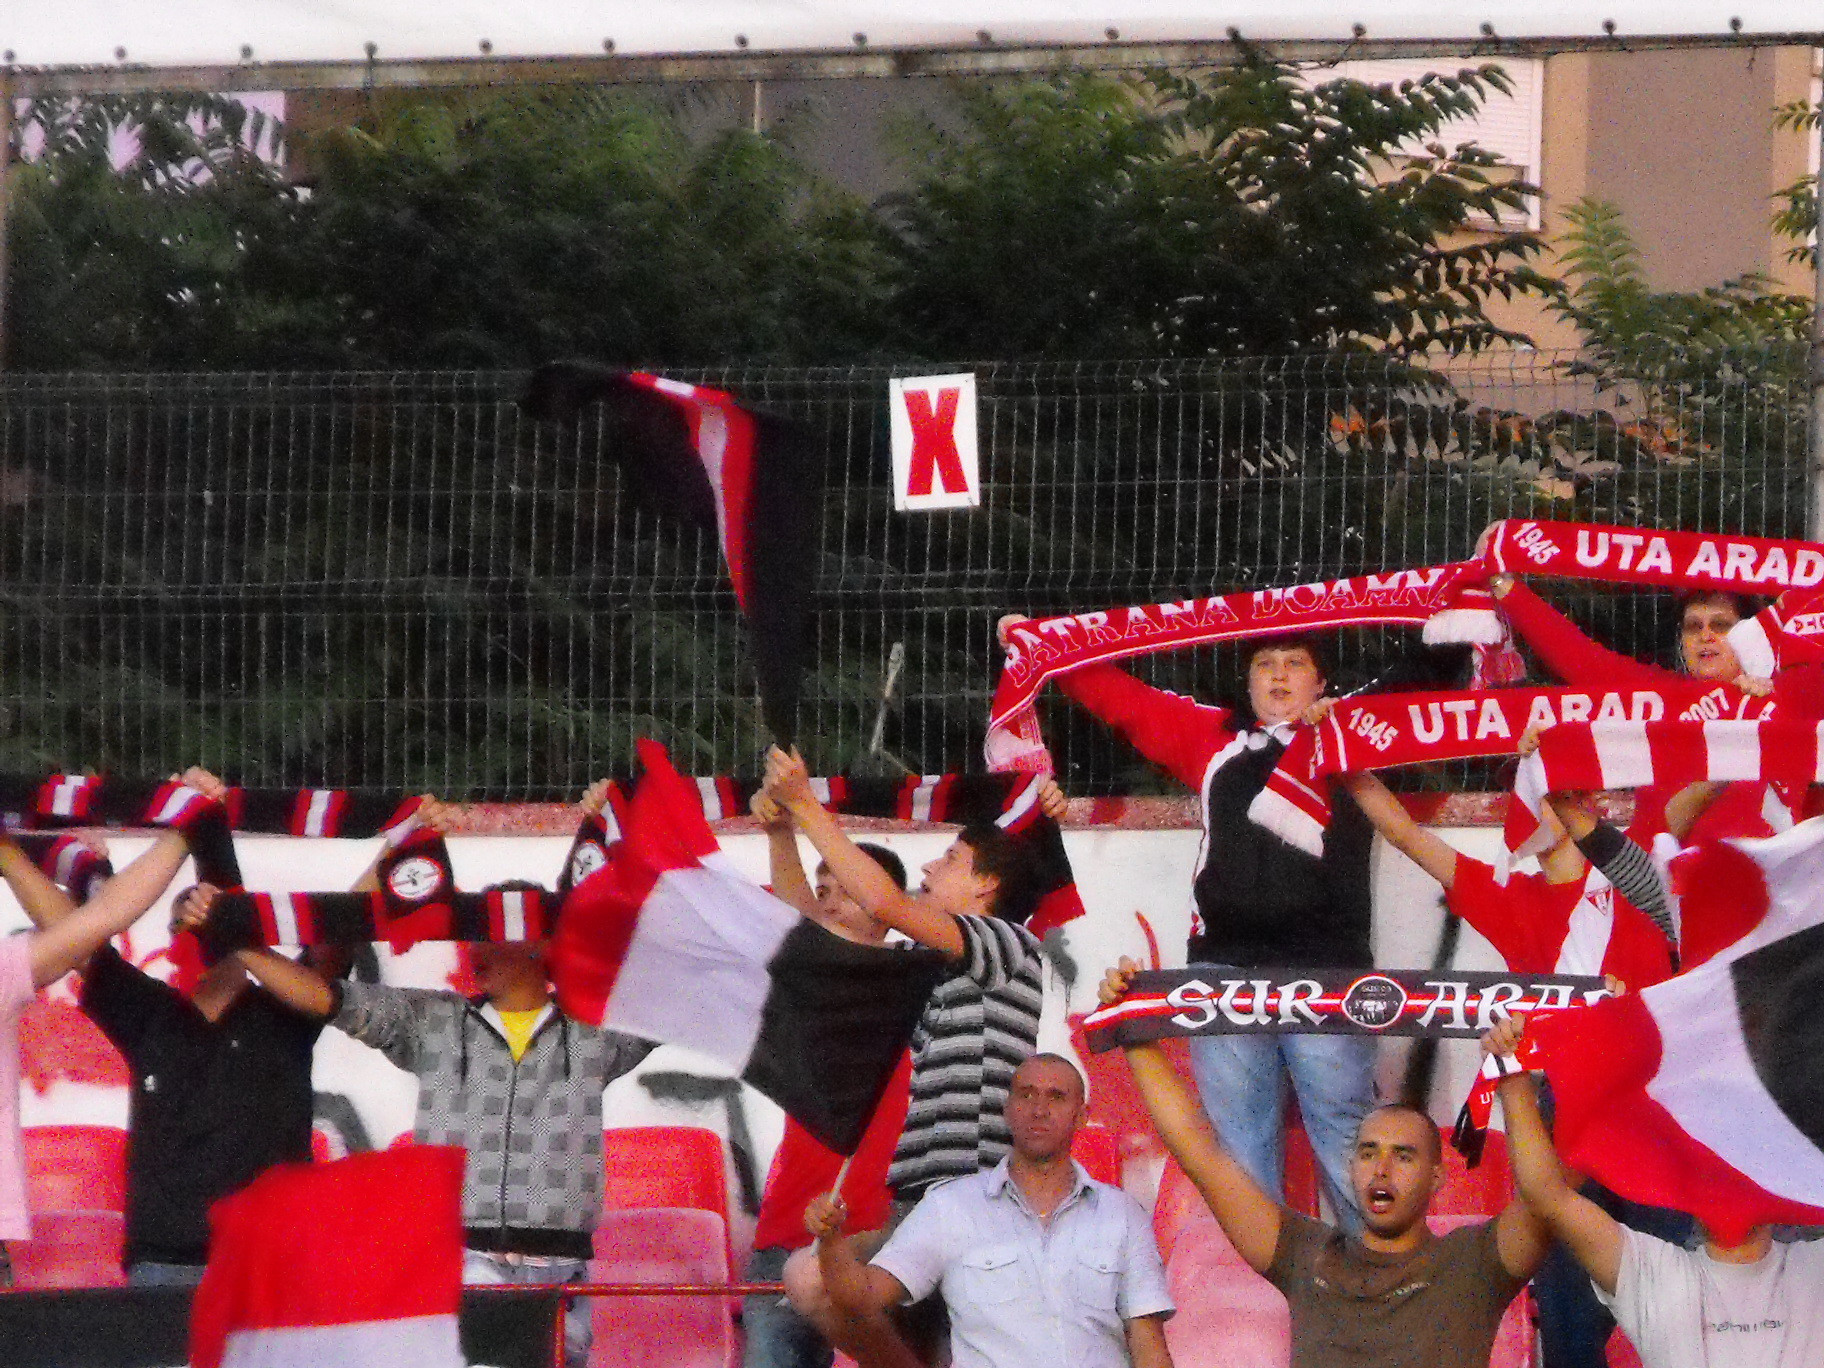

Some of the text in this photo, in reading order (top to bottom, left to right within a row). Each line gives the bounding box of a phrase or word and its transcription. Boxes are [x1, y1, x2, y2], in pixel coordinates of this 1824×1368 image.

[903, 386, 969, 496] X
[1512, 522, 1560, 565] 1945
[1576, 530, 1674, 576] UTA
[1348, 706, 1398, 753] 1945
[1408, 699, 1511, 744] UTA
[1526, 690, 1664, 729] ARAD
[1167, 979, 1614, 1032] SUR ARA
